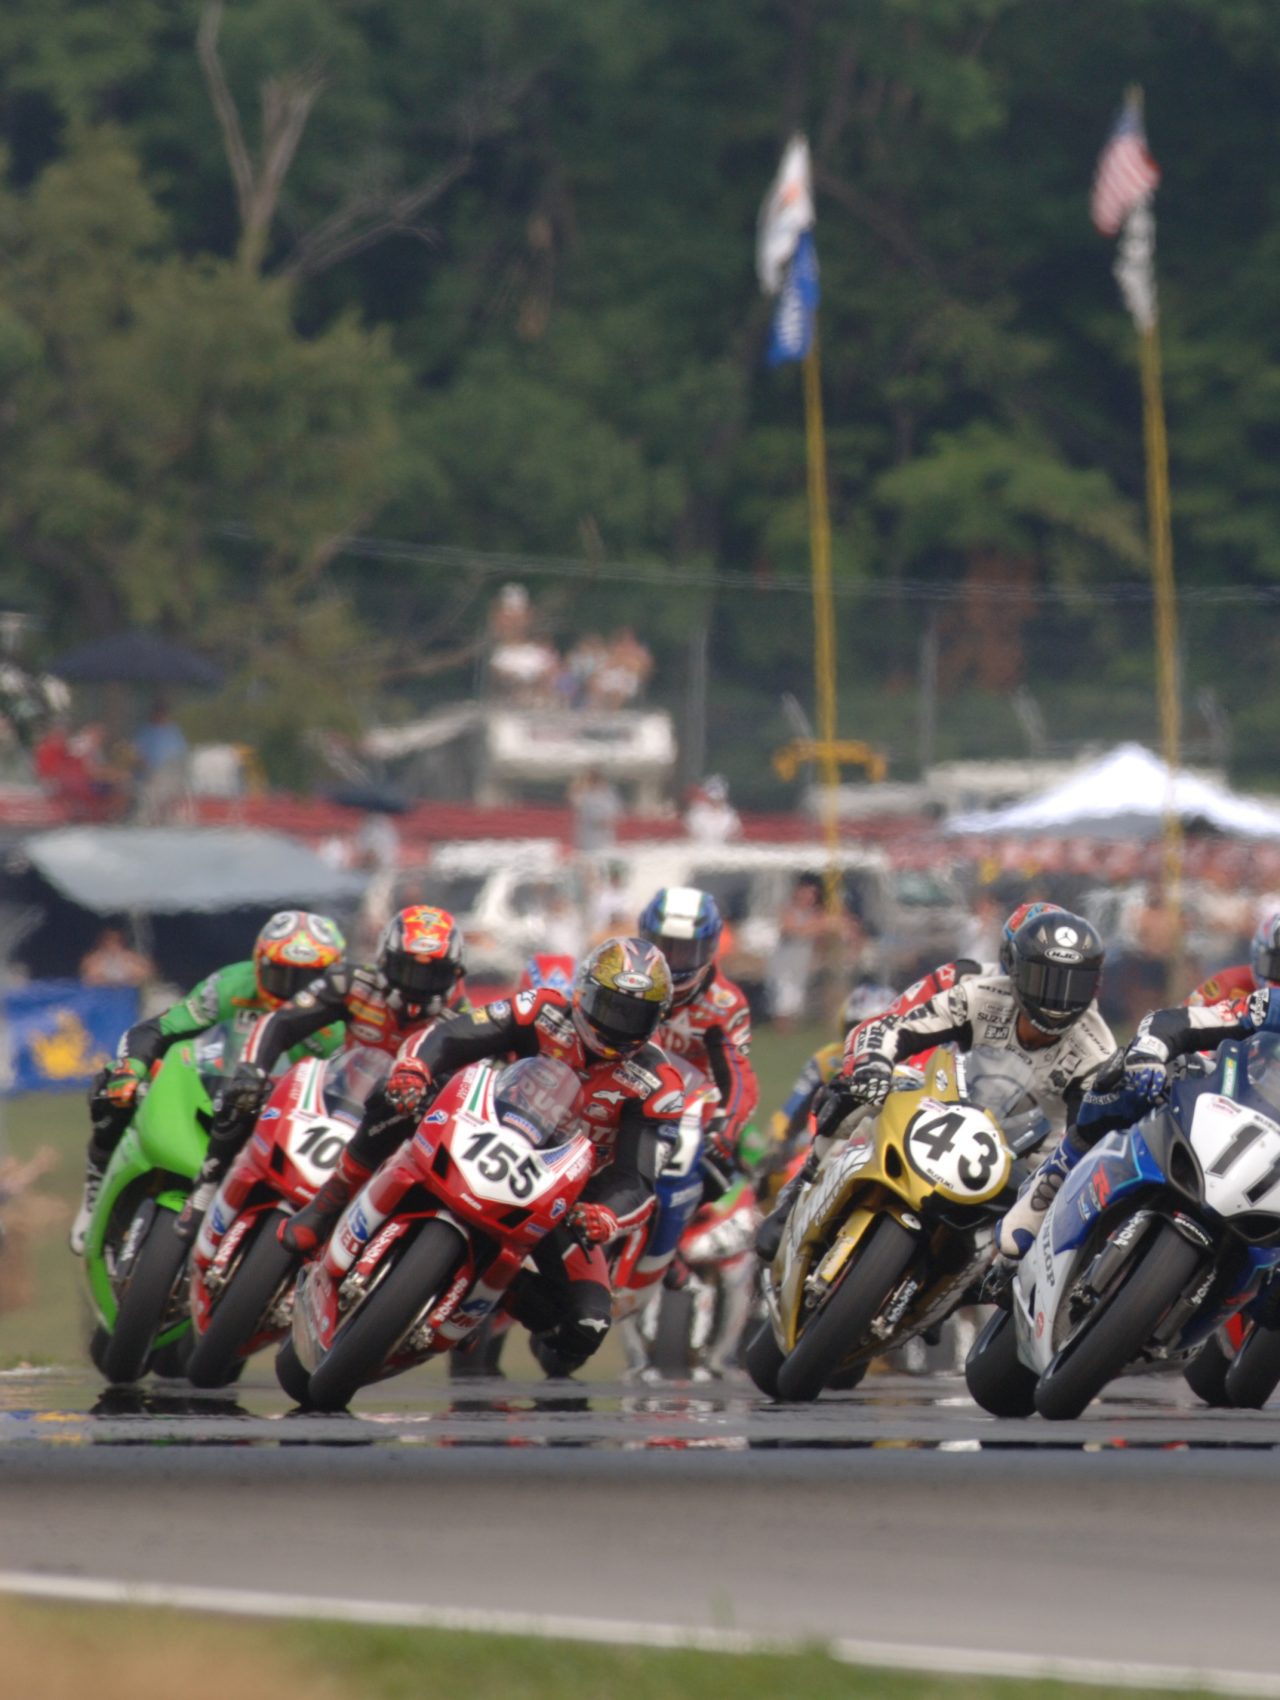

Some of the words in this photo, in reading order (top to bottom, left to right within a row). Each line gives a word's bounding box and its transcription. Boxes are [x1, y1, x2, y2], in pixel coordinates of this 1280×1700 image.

[461, 1131, 542, 1199] 155
[911, 1111, 999, 1191] 43
[925, 1167, 955, 1190] SUZUKI
[1174, 1217, 1210, 1246] SUZUKI
